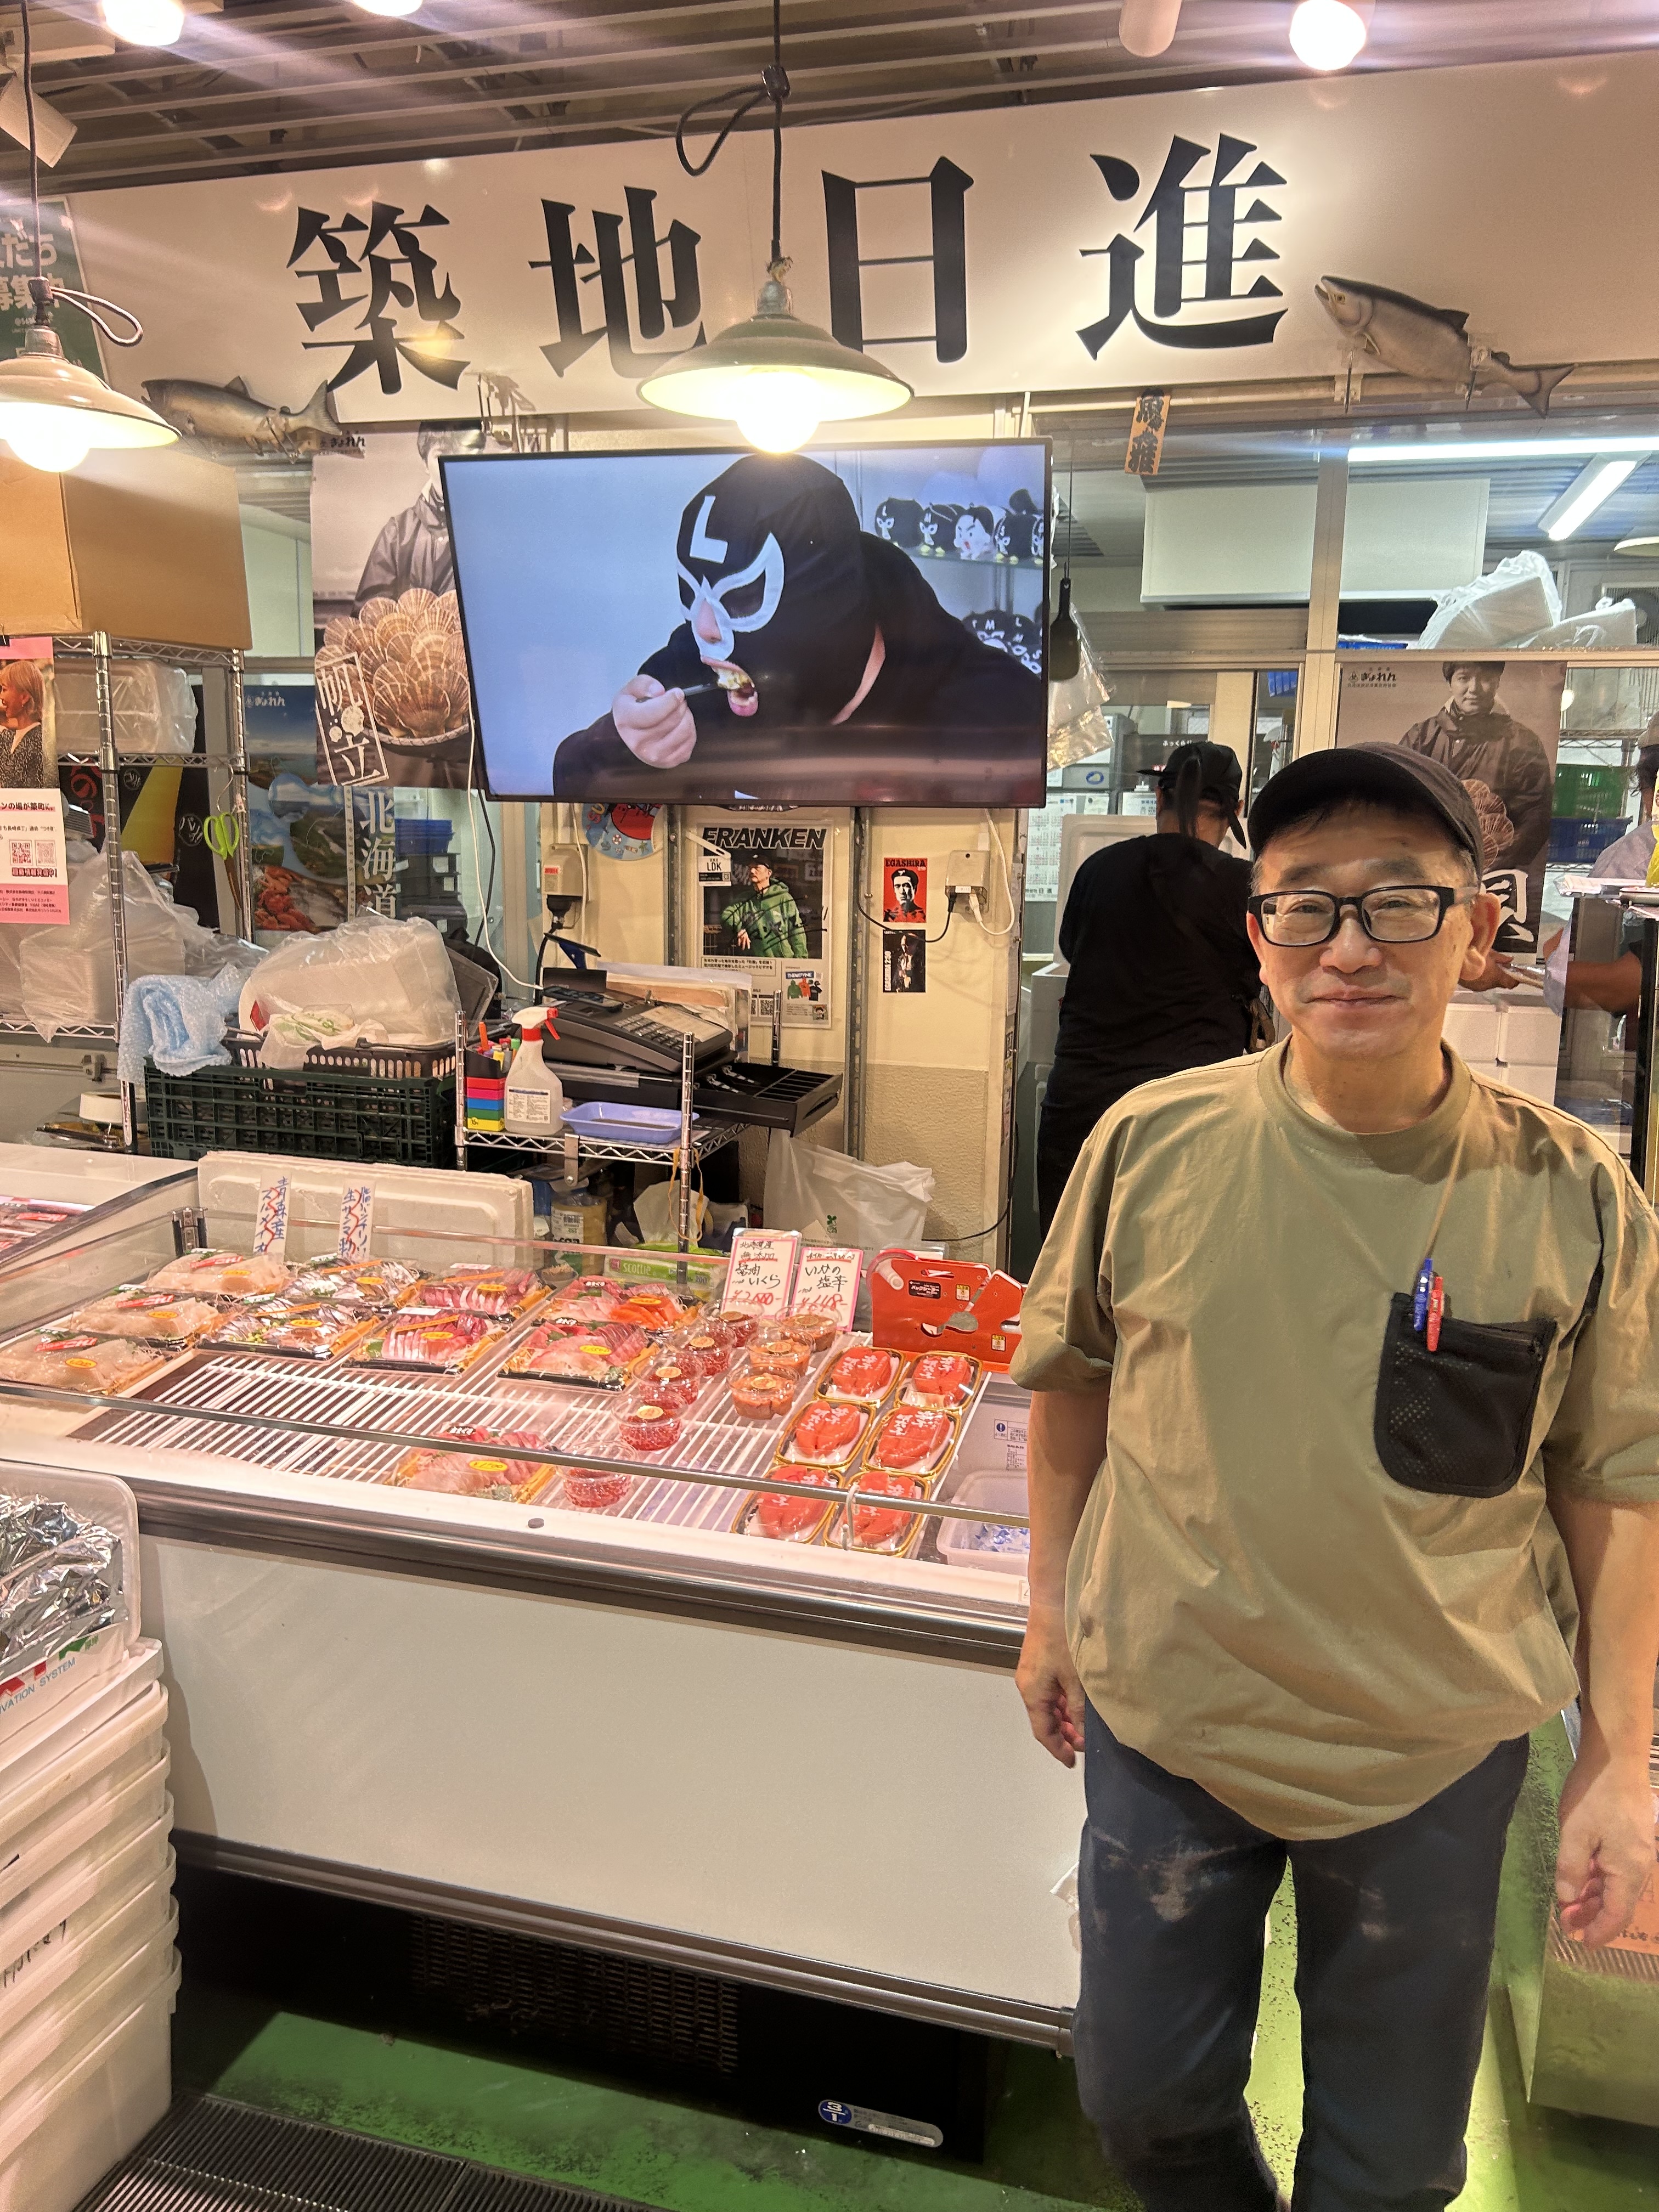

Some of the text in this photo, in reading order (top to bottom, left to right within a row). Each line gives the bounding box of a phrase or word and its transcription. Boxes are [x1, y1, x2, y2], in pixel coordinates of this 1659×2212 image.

[286, 134, 1288, 395] 築地日進
[702, 827, 827, 850] FRANKEN
[707, 862, 722, 871] LDK
[885, 859, 926, 867] EGASHIRA
[805, 1263, 841, 1277] いかの
[748, 1274, 781, 1290] いくら
[816, 1275, 849, 1292] 塩辛
[0, 1657, 76, 1715] VATION SYSTEM
